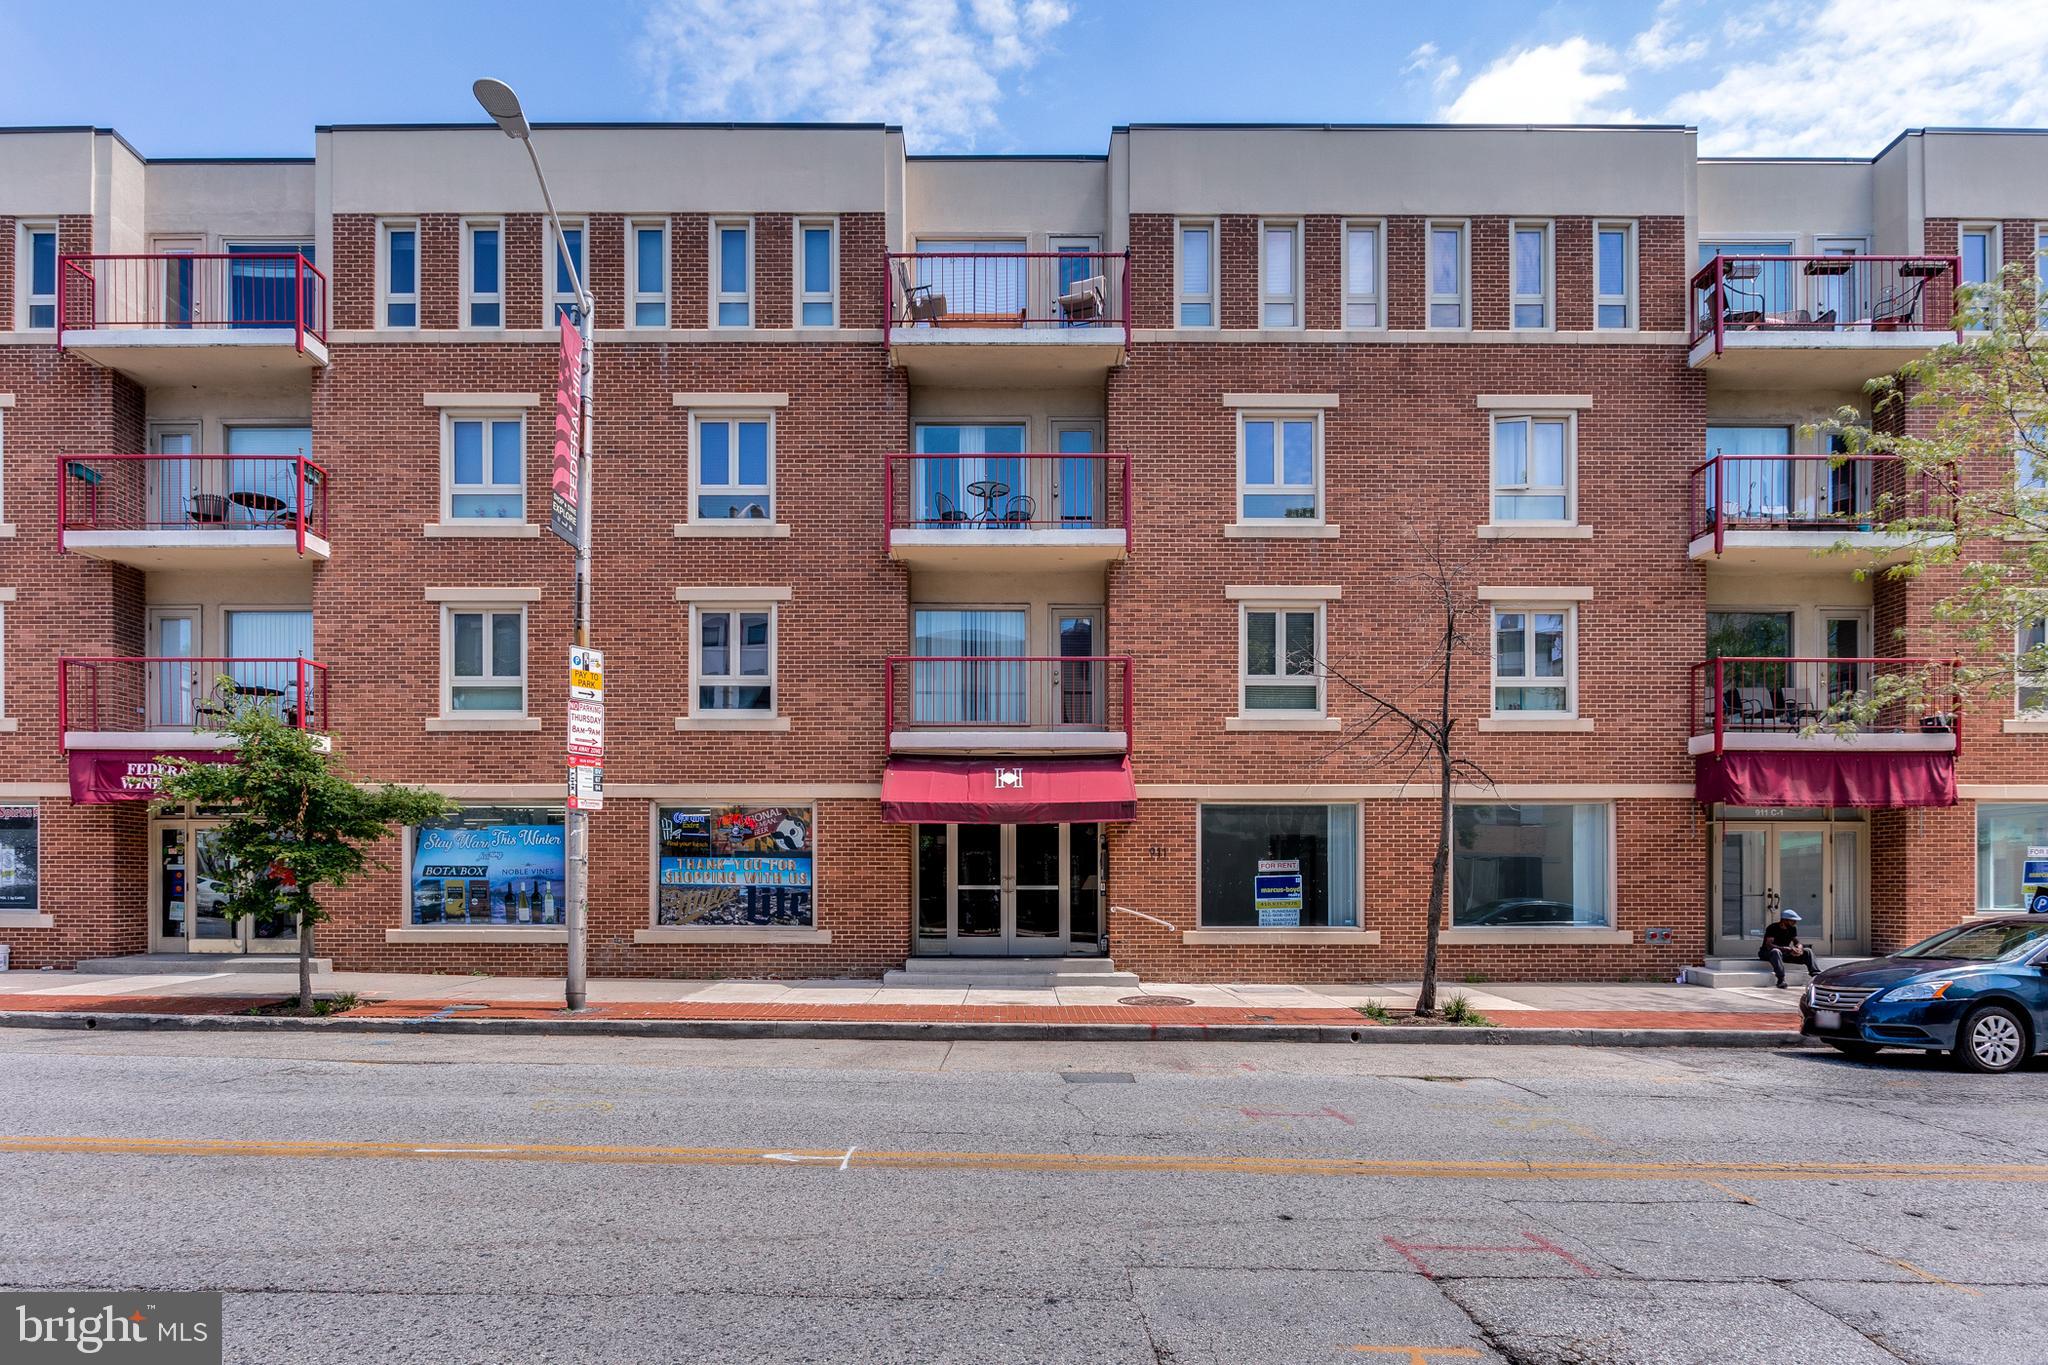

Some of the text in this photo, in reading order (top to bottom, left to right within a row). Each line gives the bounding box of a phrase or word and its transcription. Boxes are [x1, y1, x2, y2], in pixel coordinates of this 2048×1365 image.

[569, 354, 581, 503] FEDERAL HILL
[552, 500, 577, 527] EXPLORE
[575, 670, 599, 681] PAY TO
[578, 679, 596, 689] PARK
[570, 701, 601, 714] NO PARKING
[571, 712, 601, 725] THURSDAY
[571, 724, 601, 736] 8AM-9AM
[127, 762, 188, 777] FEDERA
[751, 808, 782, 822] IONAL
[1754, 808, 1783, 816] 911 C-1
[754, 826, 769, 836] BEER
[424, 833, 453, 853] Stay
[492, 828, 517, 847] This
[518, 829, 561, 846] Winter
[425, 866, 486, 876] BOTA BOX
[677, 858, 797, 871] THANK YOU FOR
[502, 868, 529, 876] NOBLE
[664, 871, 808, 884] SHOPPING WITH US
